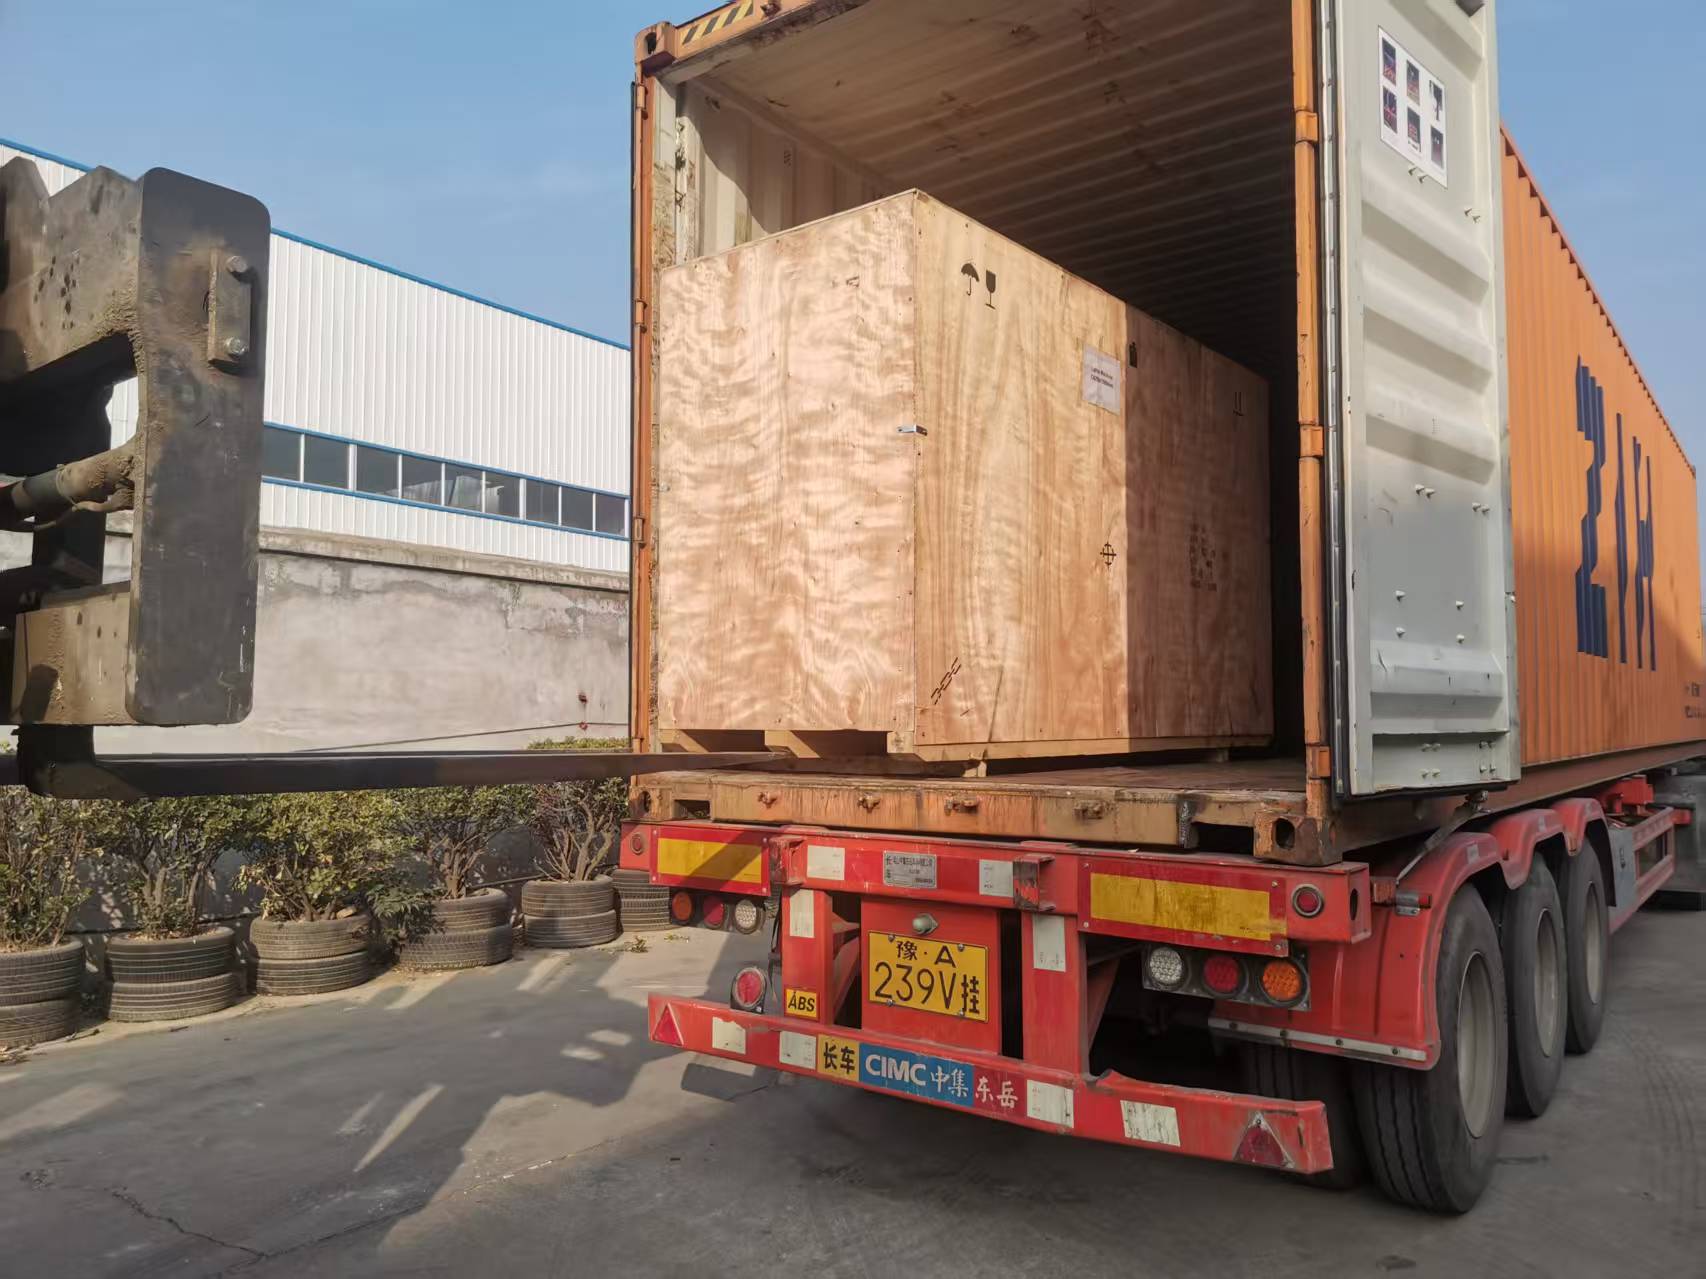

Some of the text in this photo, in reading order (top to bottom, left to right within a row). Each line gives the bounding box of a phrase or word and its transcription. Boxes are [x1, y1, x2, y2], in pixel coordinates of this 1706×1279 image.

[787, 992, 815, 1012] ABS
[874, 961, 980, 1014] 239V挂
[823, 1042, 856, 1075] 长车
[865, 1054, 1019, 1109] CIMC 中集 东岳
